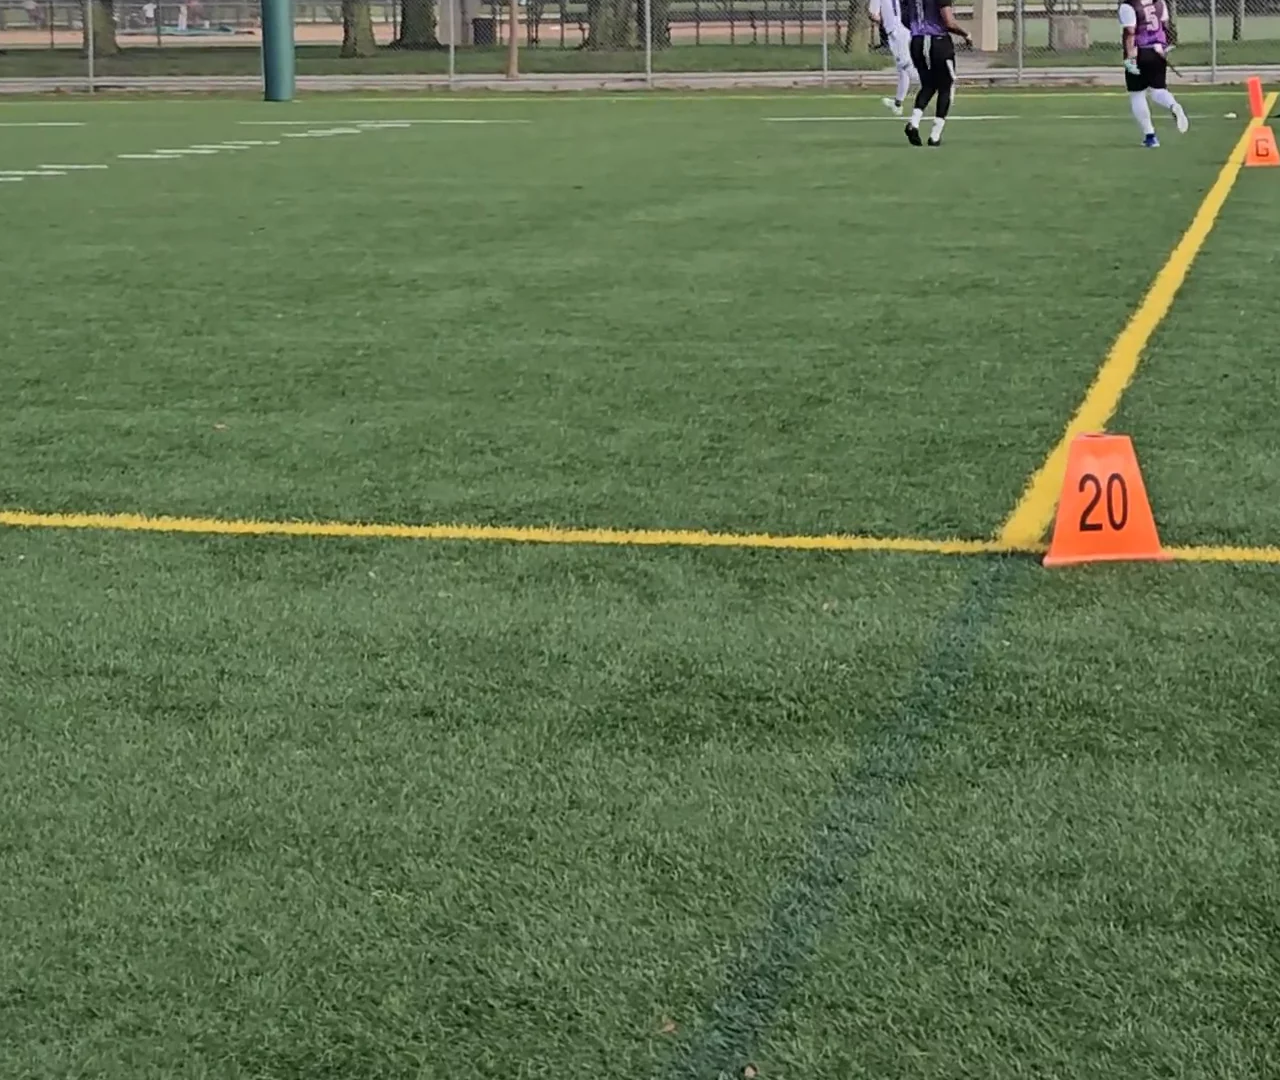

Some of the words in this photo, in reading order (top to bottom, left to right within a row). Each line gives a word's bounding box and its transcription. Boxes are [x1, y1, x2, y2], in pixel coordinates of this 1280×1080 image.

[1144, 5, 1159, 31] 5
[1256, 139, 1269, 157] G
[1079, 473, 1128, 532] 20
